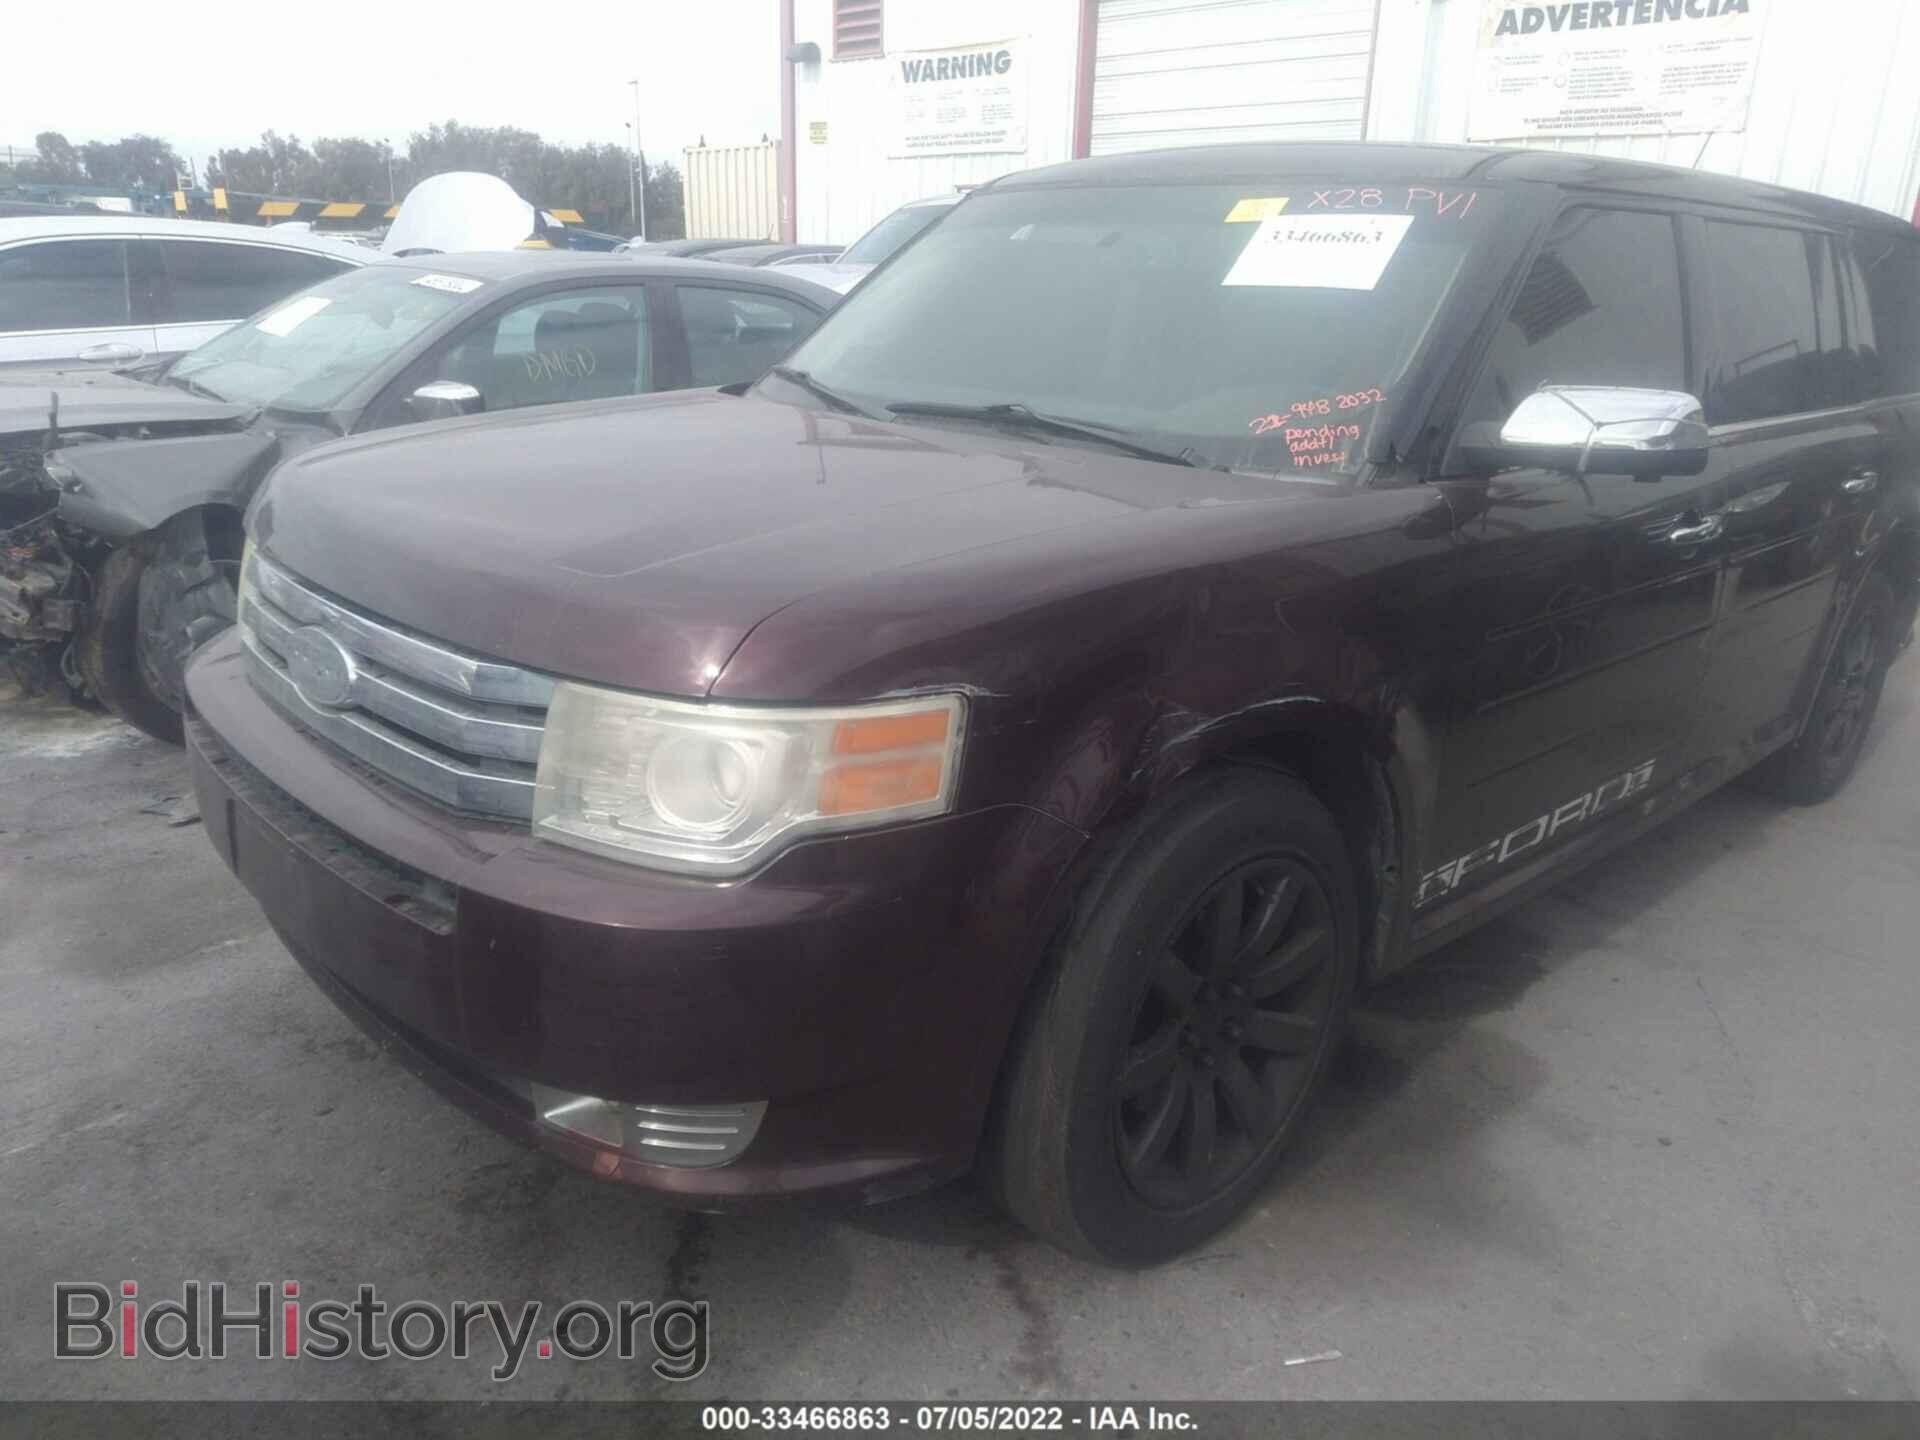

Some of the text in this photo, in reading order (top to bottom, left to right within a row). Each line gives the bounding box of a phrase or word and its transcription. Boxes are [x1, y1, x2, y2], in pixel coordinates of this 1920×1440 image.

[901, 50, 1012, 83] WARNING
[1308, 188, 1384, 209] X28
[1285, 424, 1360, 444] pending
